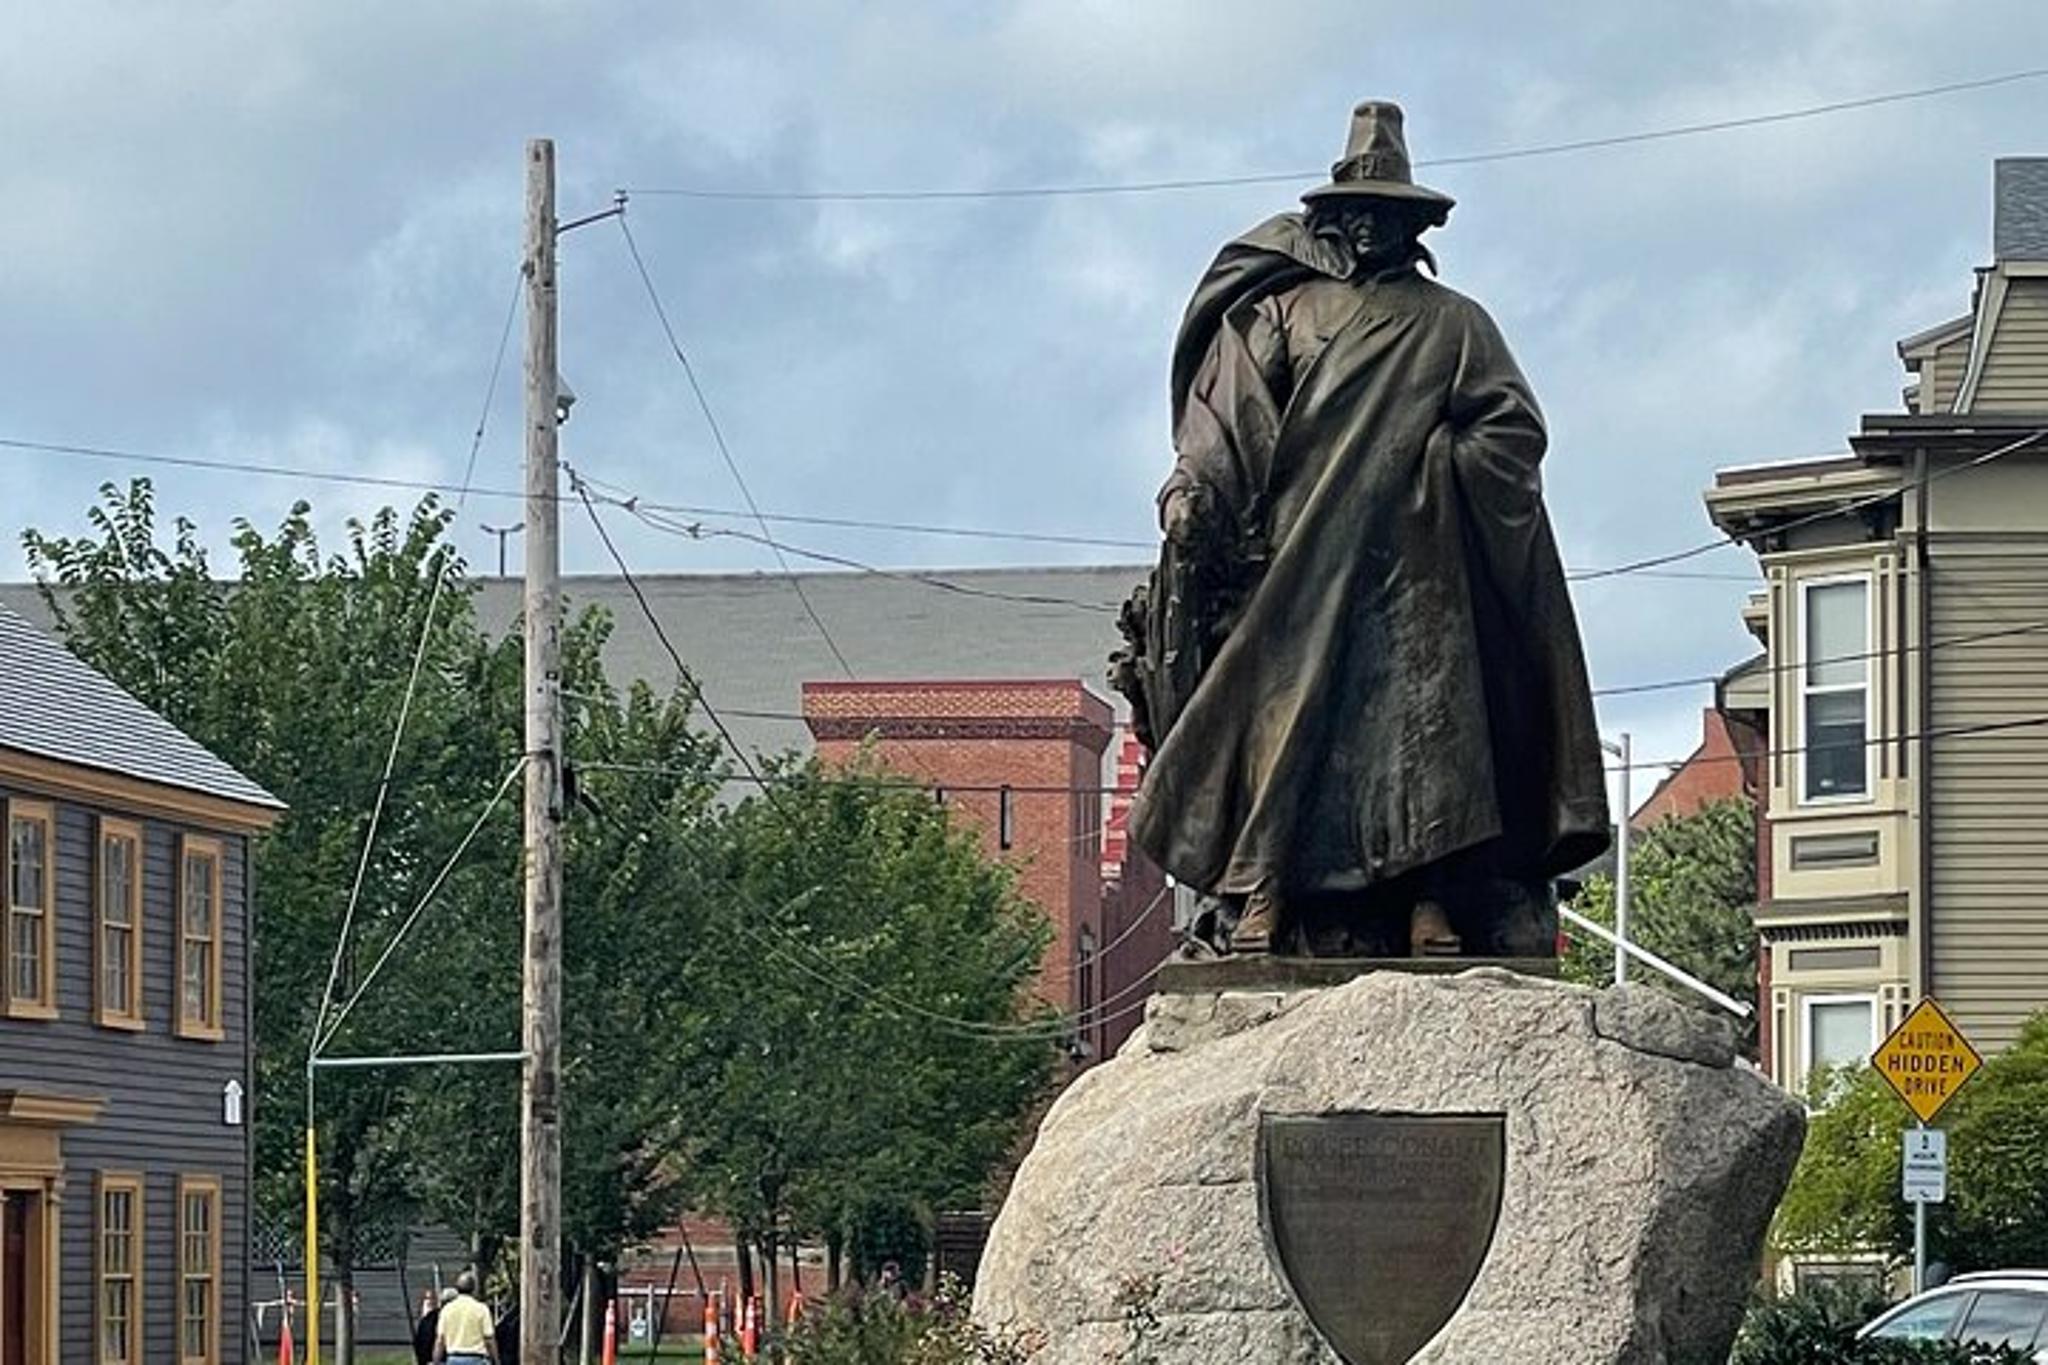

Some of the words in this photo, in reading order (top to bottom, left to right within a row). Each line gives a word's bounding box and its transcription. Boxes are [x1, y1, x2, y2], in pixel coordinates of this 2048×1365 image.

[1900, 1031, 1955, 1050] CAUTION
[1888, 1054, 1963, 1073] HIDDEN
[1905, 1077, 1947, 1096] DRIVE
